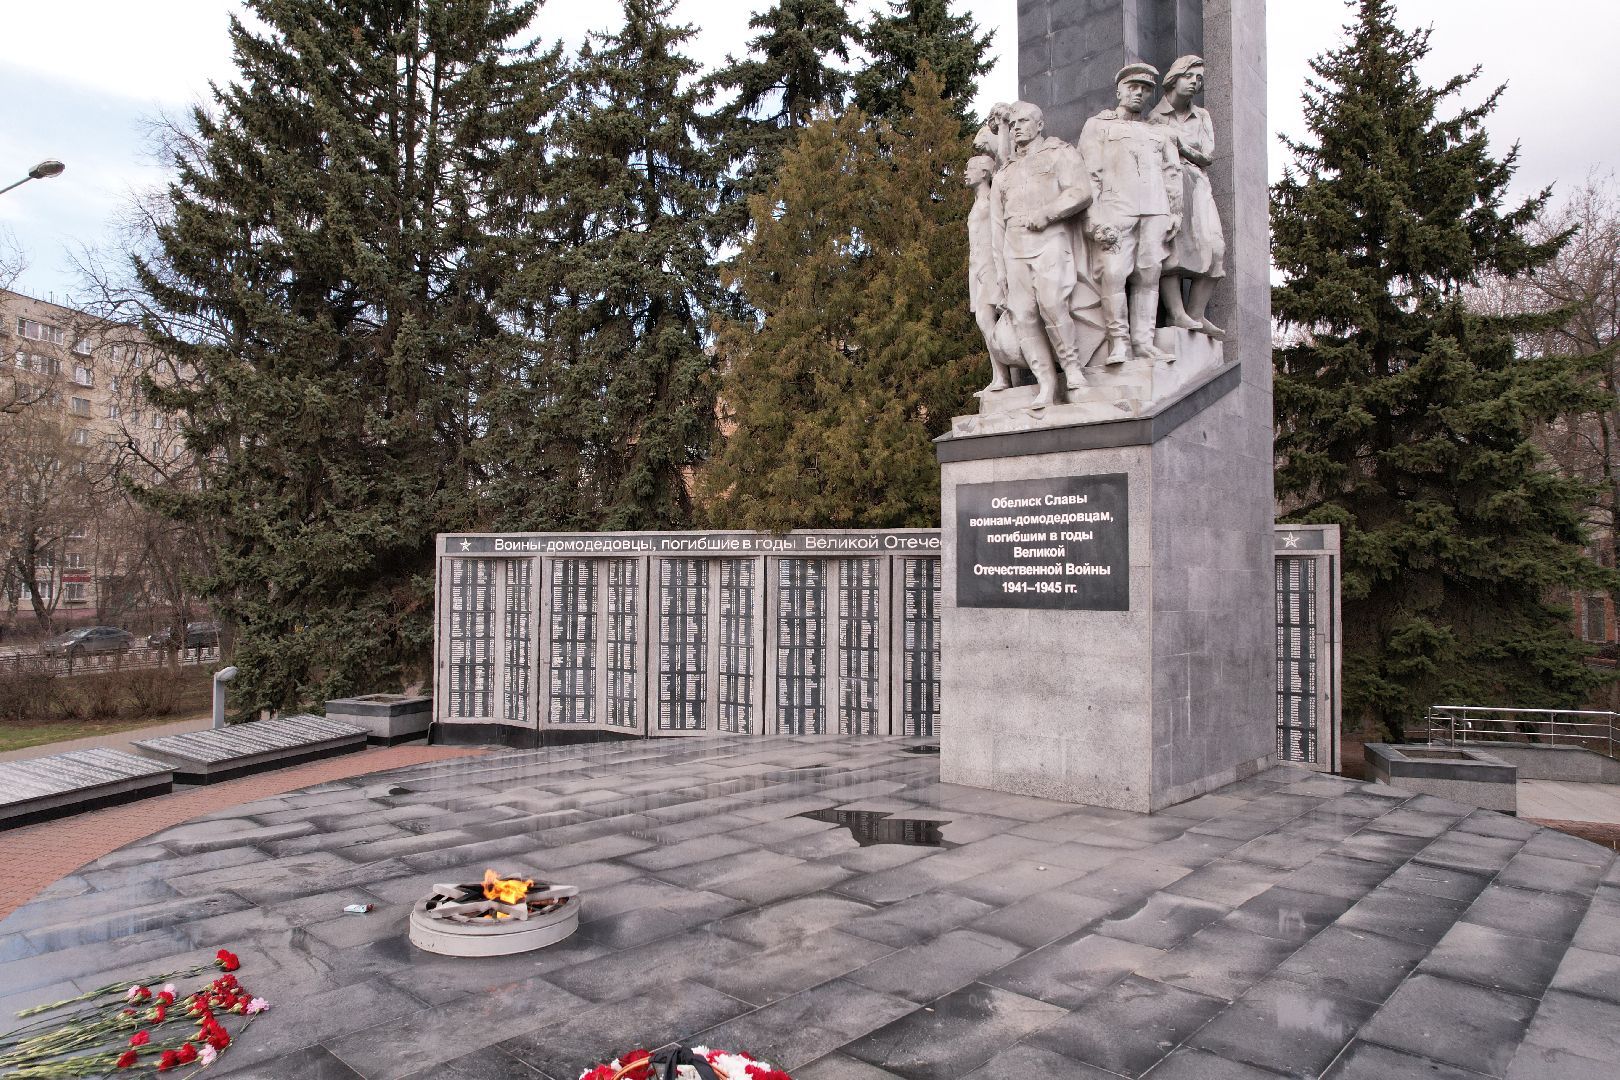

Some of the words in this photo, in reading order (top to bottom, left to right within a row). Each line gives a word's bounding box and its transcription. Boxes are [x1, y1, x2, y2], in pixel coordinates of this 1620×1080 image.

[991, 497, 1042, 509] Обелиск
[1044, 493, 1088, 506] Славы
[969, 511, 1114, 527] воинам-домодедовцам,
[494, 538, 657, 552] Воины-домодедовцы,
[661, 537, 740, 550] погибшие
[742, 539, 752, 549] в
[755, 539, 796, 552] годы
[805, 535, 879, 550] Великой
[884, 535, 942, 549] Отече
[987, 530, 1046, 543] погибшим
[1050, 532, 1058, 541] в
[1061, 530, 1093, 543] годы
[1013, 545, 1066, 558] Великой
[973, 563, 1062, 576] Отечественной
[1065, 562, 1111, 576] Войны
[1064, 583, 1078, 594] гг.
